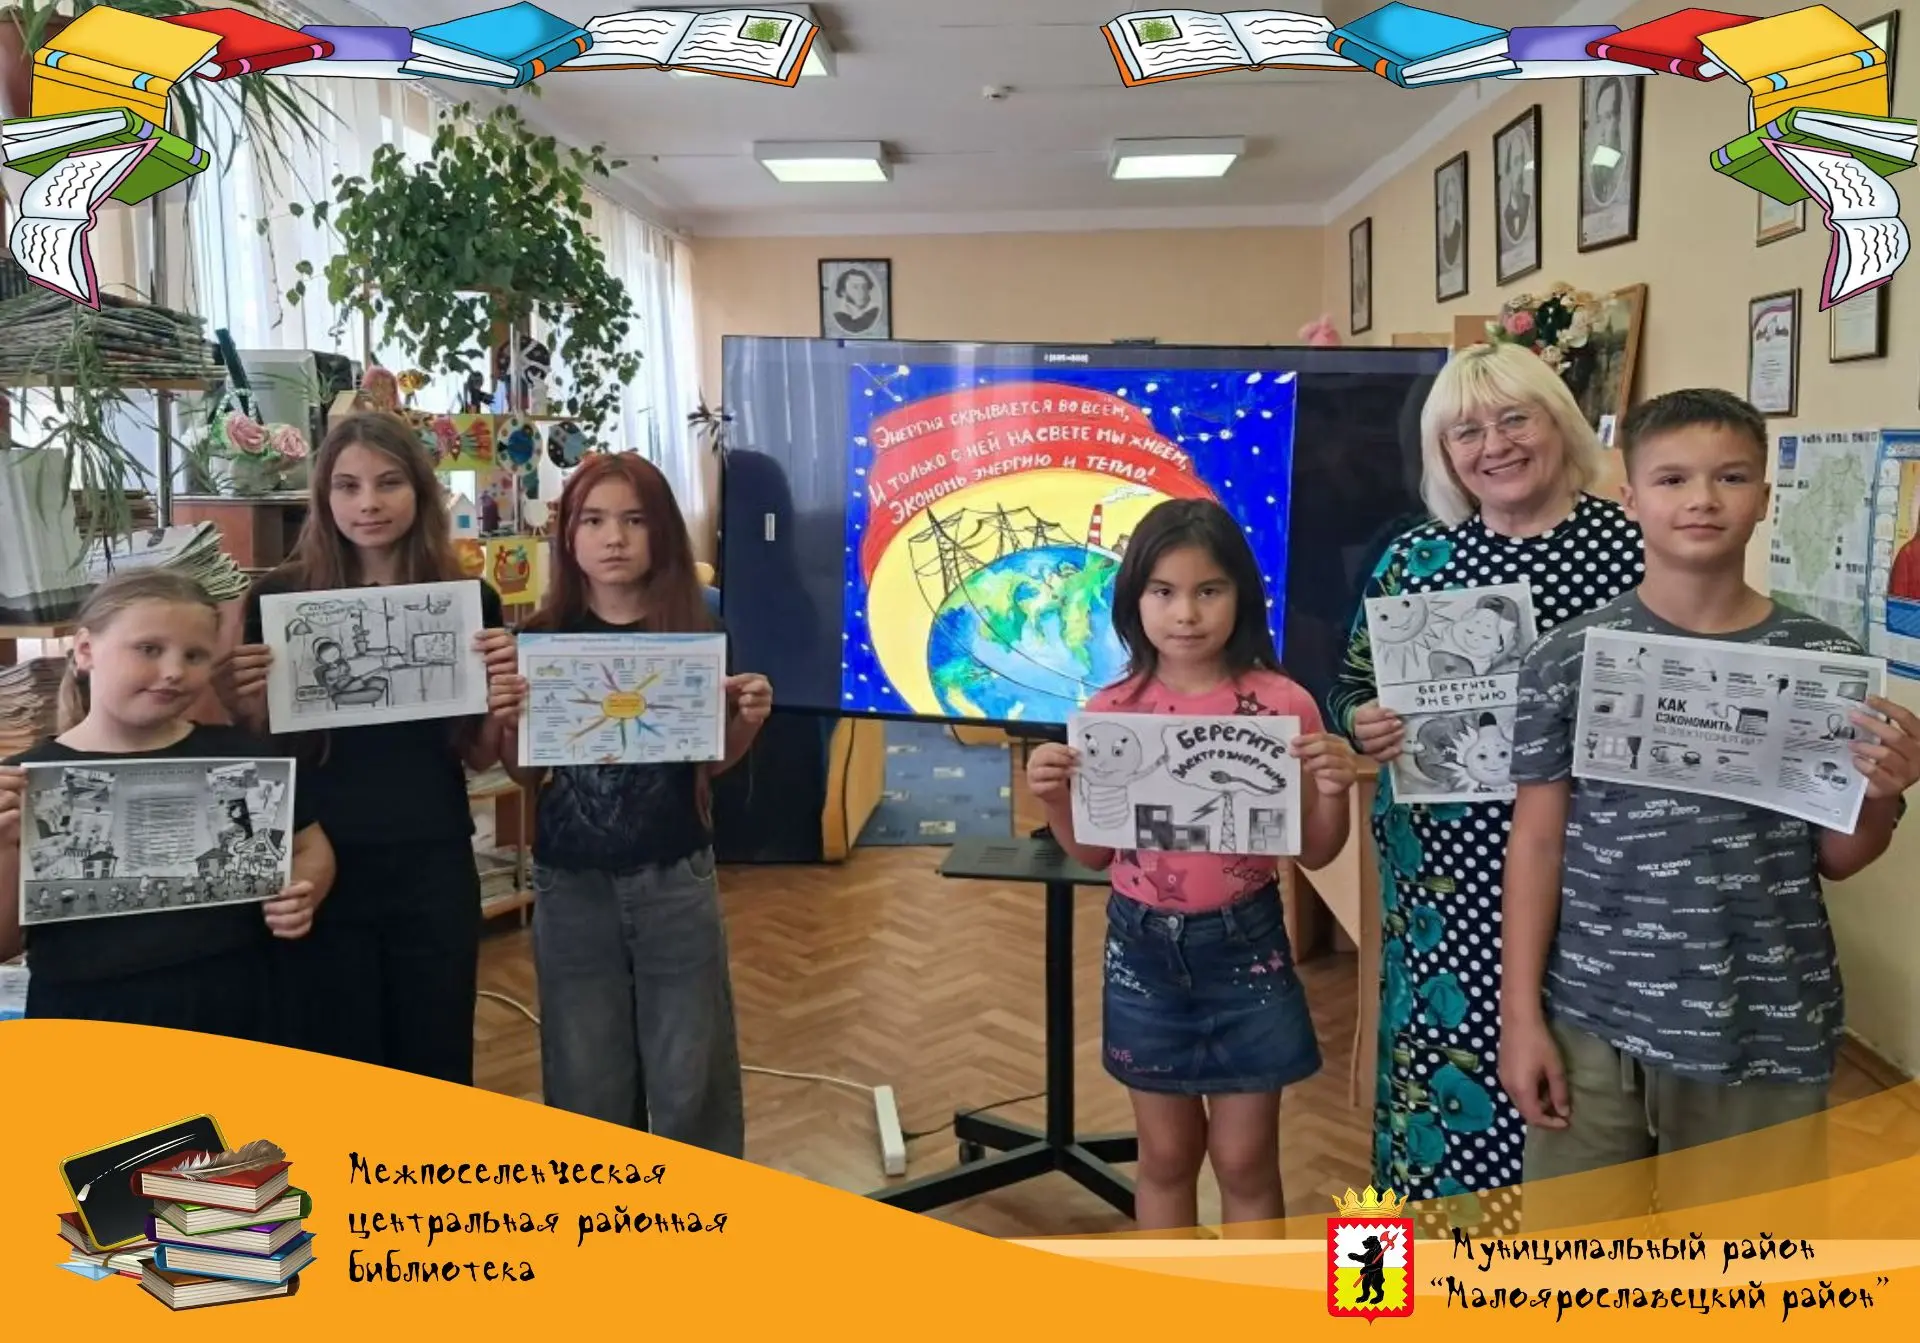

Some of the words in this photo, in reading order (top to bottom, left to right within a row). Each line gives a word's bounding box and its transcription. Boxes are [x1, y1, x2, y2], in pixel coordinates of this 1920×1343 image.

[950, 399, 1052, 427] СКРЫВАЕТСЯ
[868, 481, 887, 507] И
[887, 453, 947, 492] ТОЛЬКО
[950, 448, 962, 462] С
[966, 431, 1001, 459] НЕЙ
[1006, 430, 1034, 448] НА
[1035, 425, 1091, 442] СВЕТЕ
[1096, 427, 1126, 445] МЫ
[888, 474, 968, 525] ЭКОНОМЬ
[971, 453, 1052, 481] ЭНЕРГИЮ
[1062, 455, 1076, 468] И
[1086, 455, 1157, 483] ТЕПЛО!
[1418, 679, 1497, 695] БЕРЕГИТЕ
[1414, 690, 1507, 707] ЭНЕРГИЮ
[1657, 696, 1688, 713] КАК
[1655, 712, 1733, 732] СЭКОНОМИТЬ
